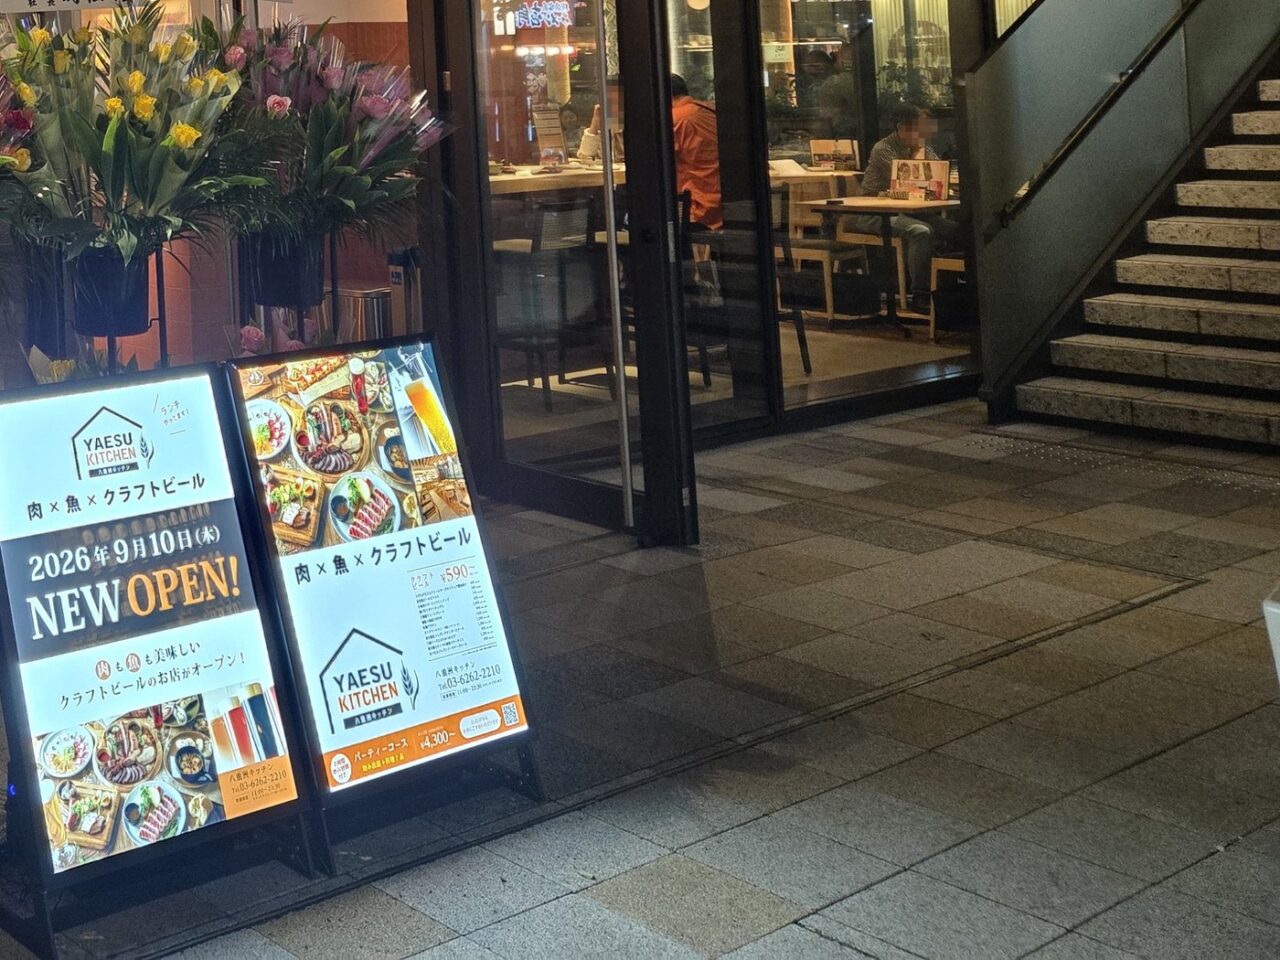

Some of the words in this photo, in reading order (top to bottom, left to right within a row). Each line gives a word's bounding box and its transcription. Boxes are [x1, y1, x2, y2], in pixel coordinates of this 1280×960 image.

[83, 432, 133, 452] YAESU
[86, 447, 136, 466] KITCHEN
[25, 578, 121, 641] NEW
[127, 555, 240, 617] OPEN!
[333, 661, 393, 693] YAESU
[338, 681, 399, 713] KITCHEN
